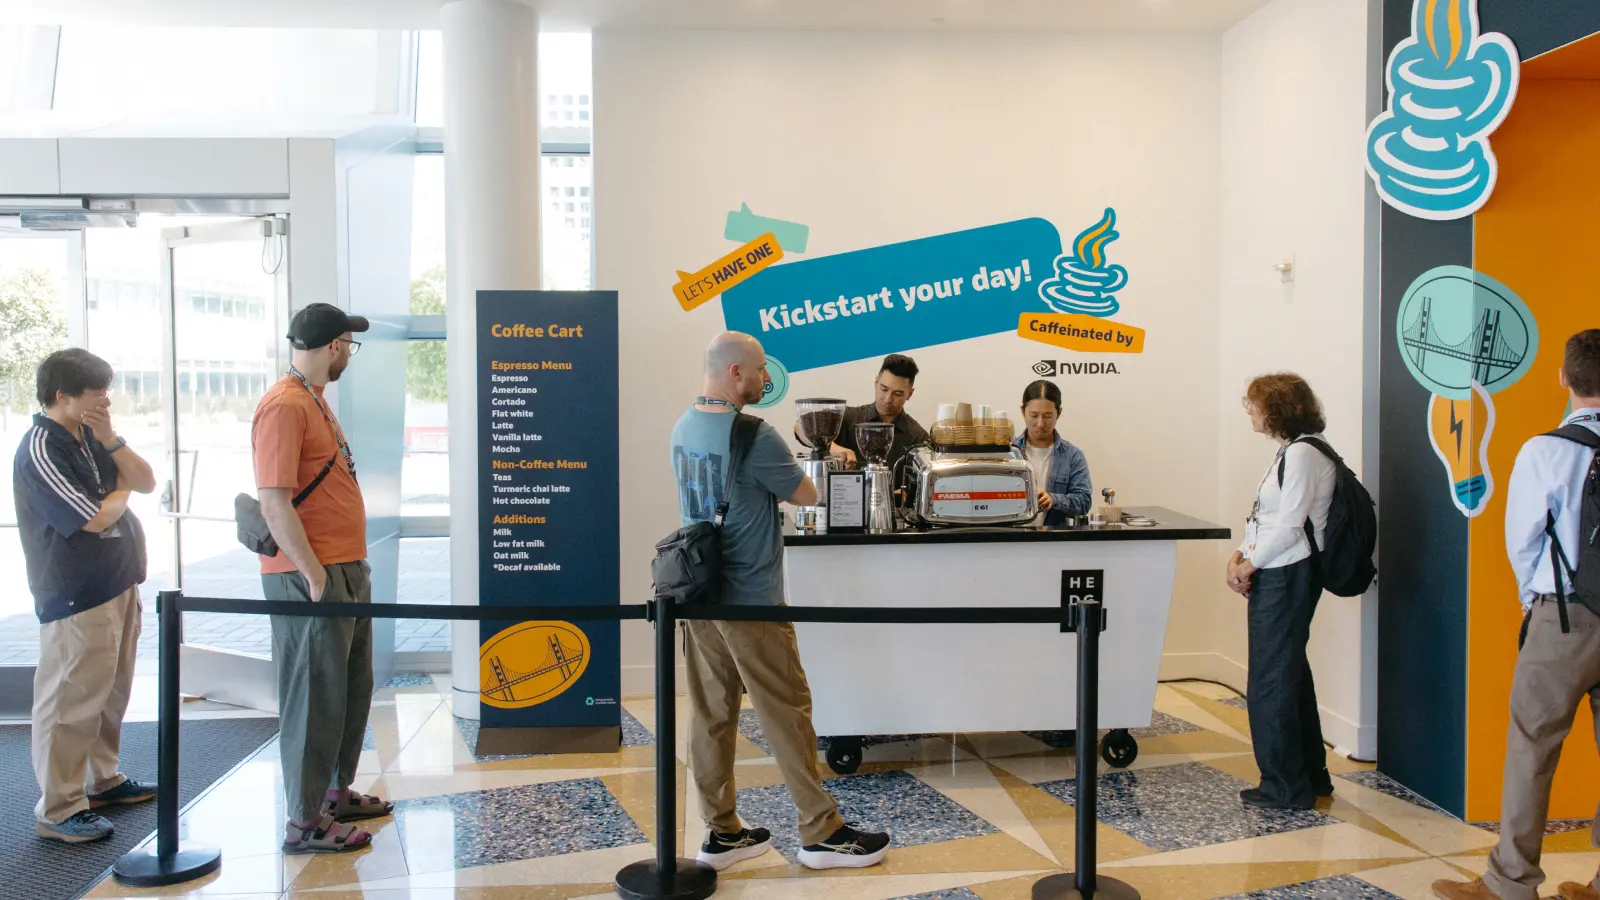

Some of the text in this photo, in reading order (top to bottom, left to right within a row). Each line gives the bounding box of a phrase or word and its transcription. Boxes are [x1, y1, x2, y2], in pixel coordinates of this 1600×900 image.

[682, 241, 774, 301] LET'S HAVE ONE
[758, 259, 1032, 332] Kickstart your day!
[491, 323, 584, 338] Coffee Cart
[1029, 319, 1134, 347] Caffeinated by
[491, 360, 573, 372] Espresso Menu
[491, 374, 529, 383] Espresso
[491, 386, 538, 394] Americano
[491, 398, 526, 406] Cortado
[492, 410, 534, 418] Flat white
[492, 433, 542, 441] Vanilla latte
[492, 445, 521, 453] Mocha
[492, 460, 588, 469] Non-Coffee Menu
[493, 473, 512, 481] Teas
[493, 485, 571, 493] Turmeric chai latte
[493, 497, 551, 505] Hot chocolate
[493, 514, 547, 524] Additions
[493, 528, 512, 536] Milk
[493, 540, 545, 548] Low fat milk
[493, 552, 529, 560] Oat milk
[523, 563, 561, 571] available
